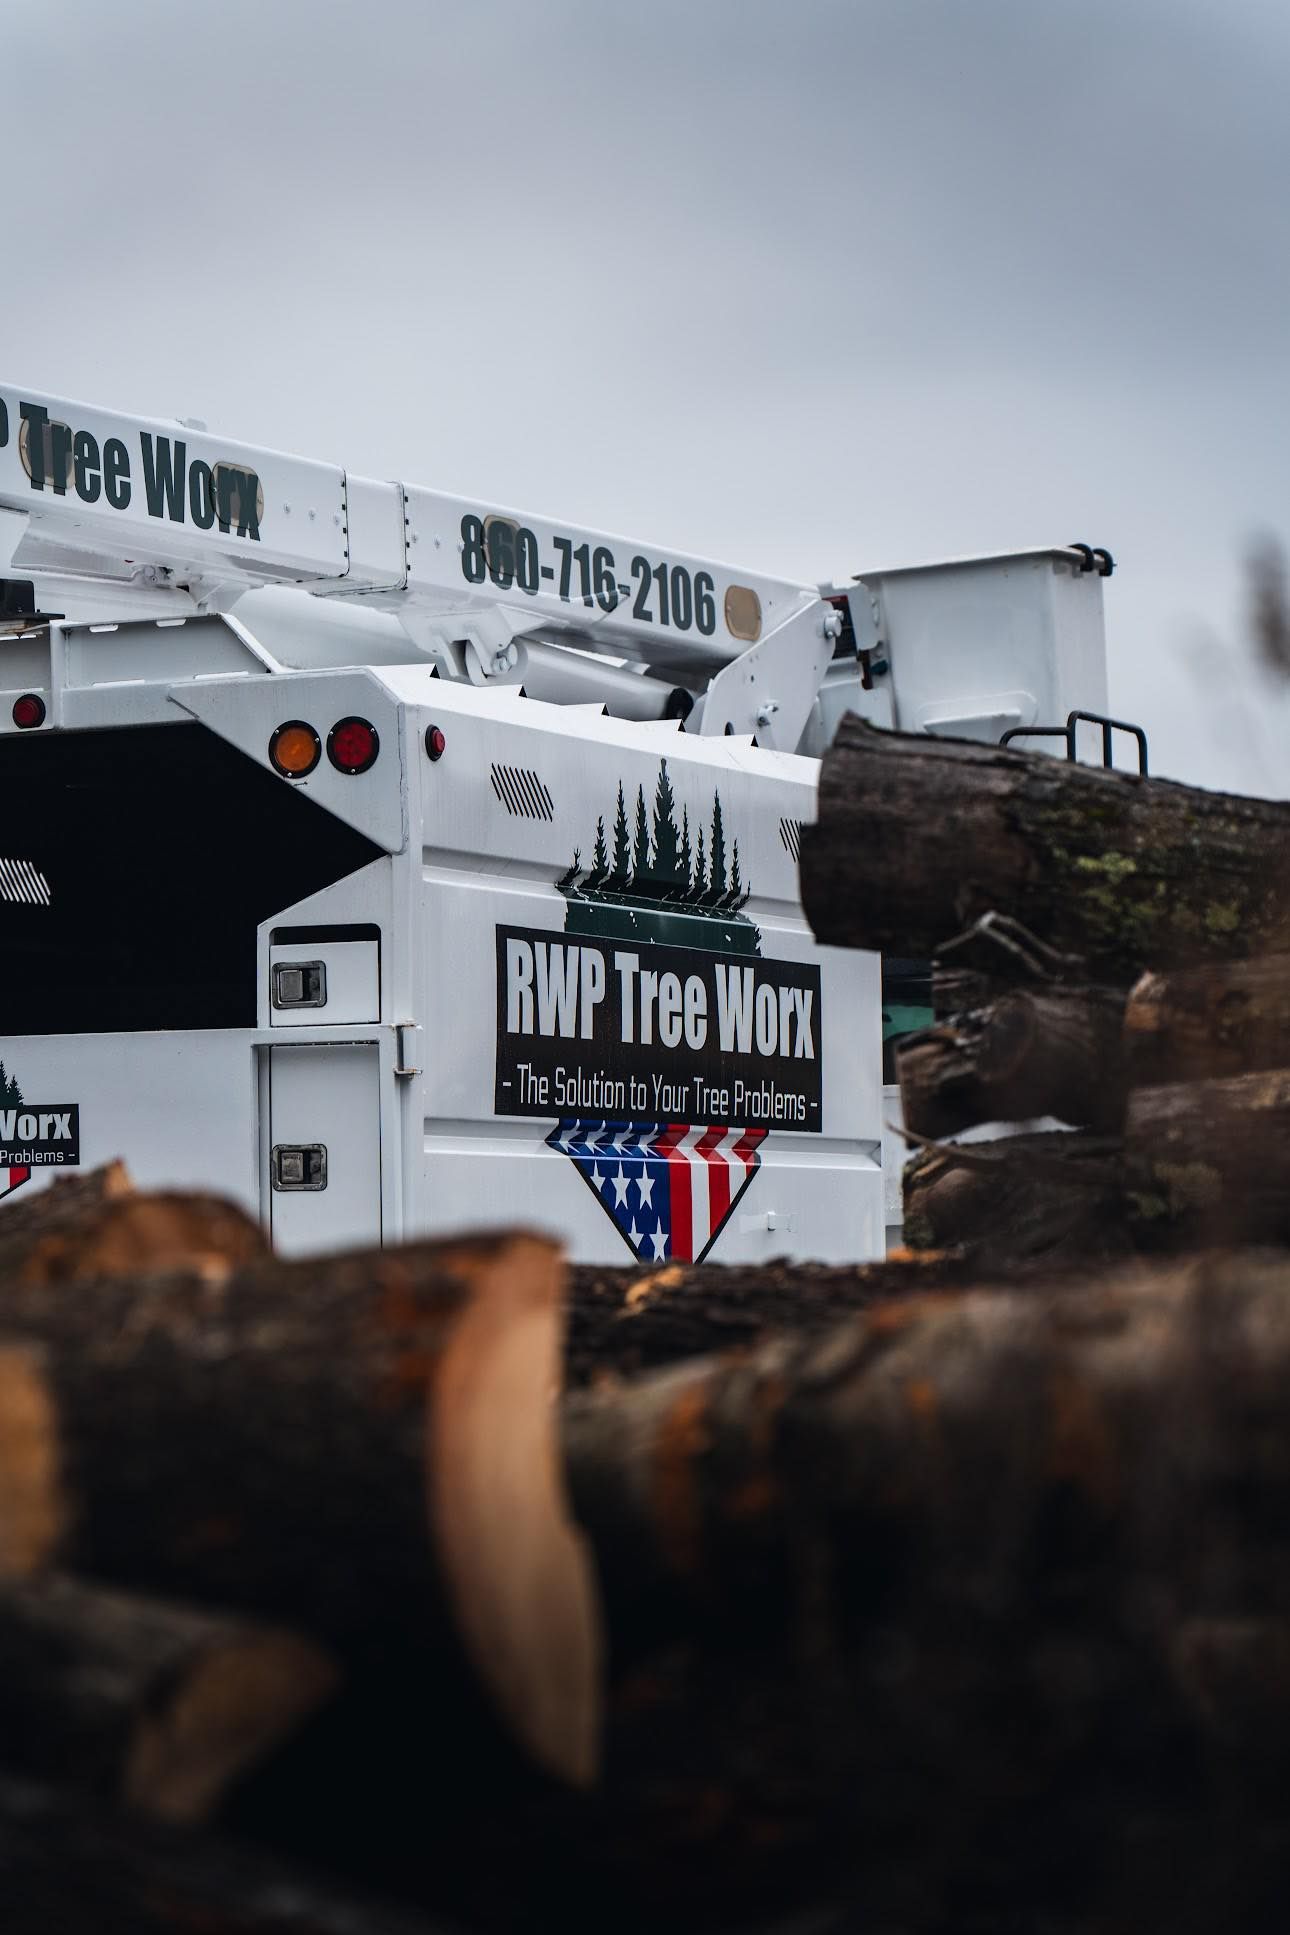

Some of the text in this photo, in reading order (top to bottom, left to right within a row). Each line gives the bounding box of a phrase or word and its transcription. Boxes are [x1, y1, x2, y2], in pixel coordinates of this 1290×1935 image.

[20, 401, 131, 510] Tree
[140, 431, 261, 541] Worx
[460, 514, 716, 636] 860-716-2106
[506, 938, 814, 1060] RWP Tree Worx
[517, 1063, 548, 1105] The
[555, 1066, 625, 1109] Solution
[630, 1077, 647, 1111] to
[652, 1073, 690, 1113] Your
[693, 1077, 728, 1116] Tree
[734, 1080, 806, 1121] Problems
[0, 1149, 64, 1164] Problems
